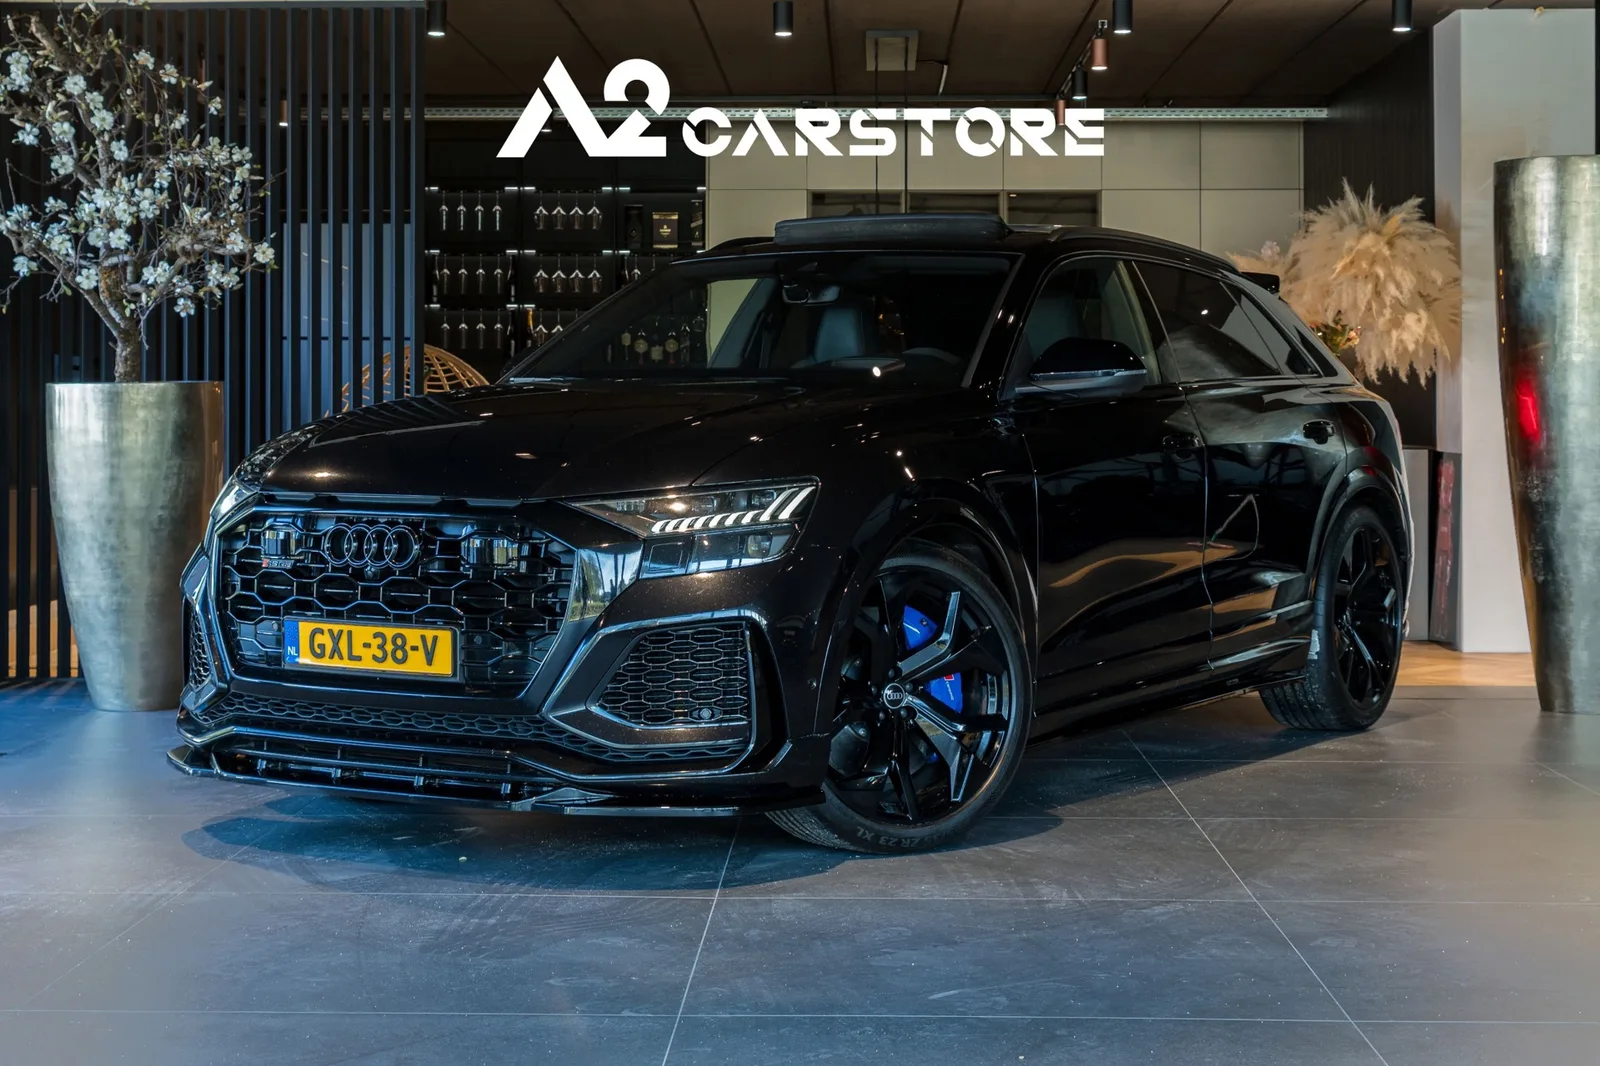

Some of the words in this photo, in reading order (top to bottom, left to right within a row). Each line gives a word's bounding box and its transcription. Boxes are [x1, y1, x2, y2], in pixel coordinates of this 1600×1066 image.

[287, 645, 299, 656] NL
[308, 627, 438, 666] GXL-38-V
[856, 825, 876, 841] XL
[879, 835, 899, 847] 23
